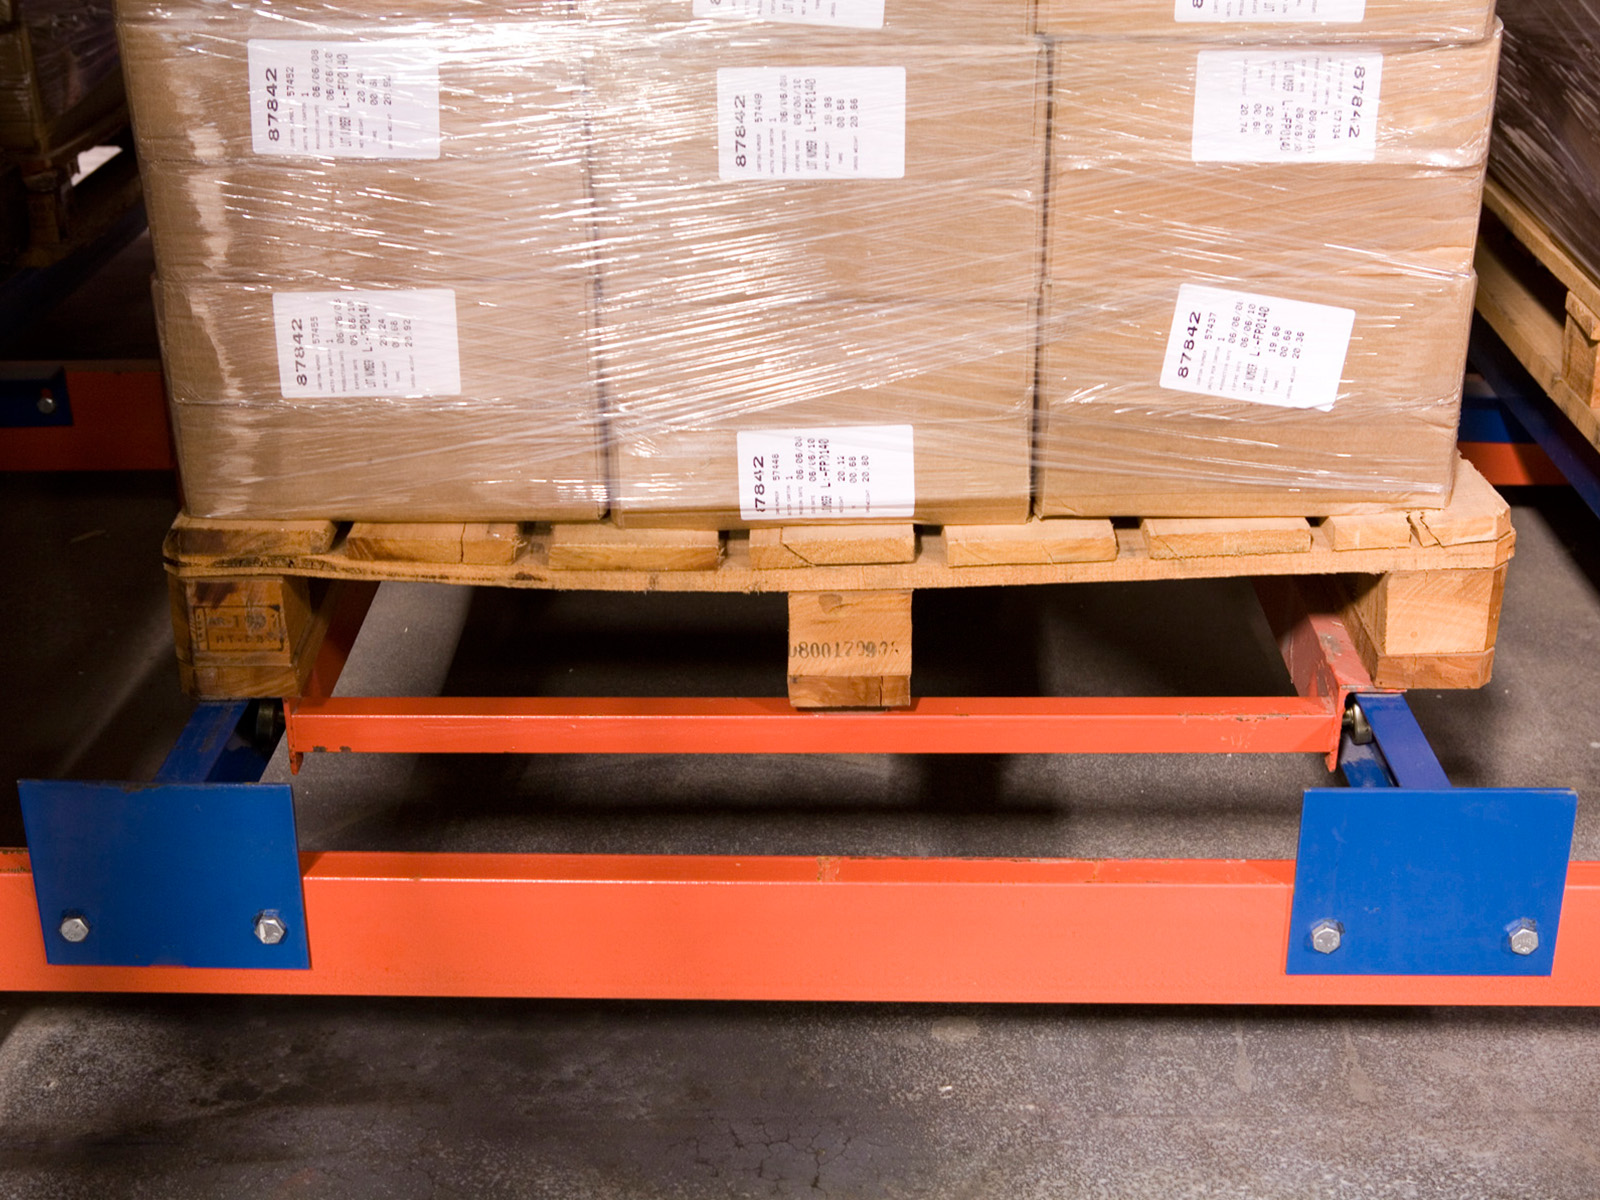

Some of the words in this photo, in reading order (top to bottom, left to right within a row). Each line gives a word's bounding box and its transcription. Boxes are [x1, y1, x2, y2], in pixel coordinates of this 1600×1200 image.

[286, 67, 294, 97] 57452
[311, 49, 320, 98] 06/06/08
[325, 52, 334, 101] 06/06/10
[266, 67, 279, 142] 87842
[754, 93, 762, 123] 57449
[793, 78, 801, 125] 06/06/10
[1349, 66, 1366, 138] 87842
[734, 95, 746, 167] 87842
[311, 316, 320, 344] 57455
[347, 301, 358, 345] 0606/10
[1178, 311, 1201, 378] 87842
[1204, 312, 1216, 340] 57437
[1240, 304, 1256, 348] 06/06/10
[291, 318, 307, 386] 87842
[807, 438, 816, 482] 06/06/10
[849, 456, 857, 483] 00.68
[861, 455, 870, 482] 20.80
